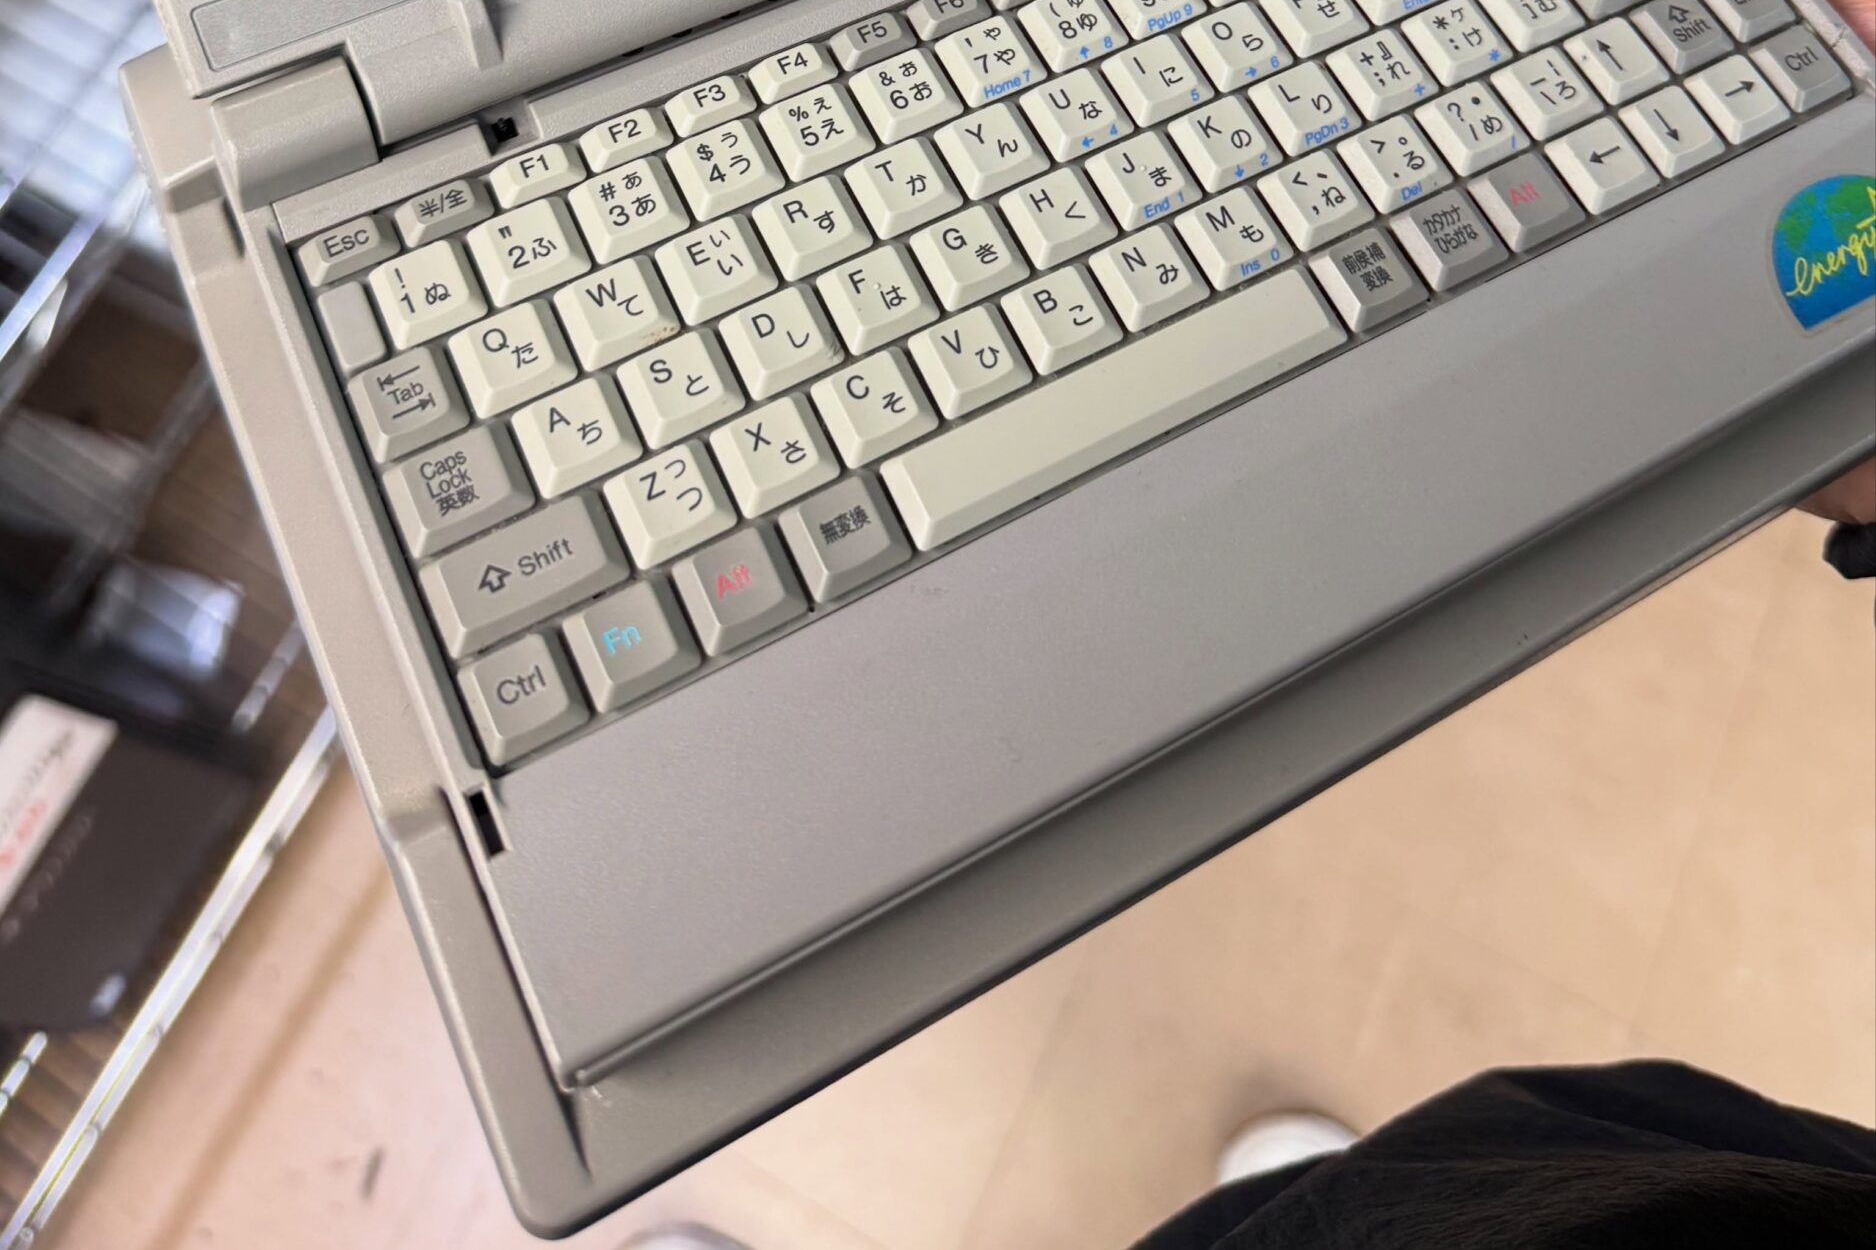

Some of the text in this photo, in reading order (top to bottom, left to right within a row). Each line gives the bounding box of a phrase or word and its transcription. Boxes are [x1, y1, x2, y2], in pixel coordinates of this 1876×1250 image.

[1147, 4, 1193, 31] PgUp 9
[1317, 0, 1340, 18] せ
[857, 22, 887, 43] F5
[1058, 13, 1097, 38] 8 ゆ
[1462, 28, 1483, 47] け
[1673, 18, 1710, 42] Shift
[1104, 37, 1112, 49] 8
[1242, 34, 1263, 51] ら
[777, 53, 808, 75] F4
[974, 48, 1015, 74] 7 や
[1270, 57, 1279, 68] 6
[1387, 61, 1410, 79] れ
[1784, 47, 1820, 72] Ctrl
[983, 70, 1032, 99] Home 7
[1159, 67, 1183, 87] に
[1556, 81, 1576, 99] ろ
[693, 85, 726, 108] F3
[890, 82, 932, 109] 6 お
[1049, 89, 1102, 119] U な
[1191, 89, 1199, 101] 5
[1278, 84, 1333, 114] L り
[611, 117, 642, 143] F2
[802, 119, 844, 145] 5 え
[1109, 124, 1118, 137] 4
[1198, 117, 1251, 149] K の
[1304, 118, 1350, 146] PgDn 3
[1481, 116, 1503, 134] め
[965, 124, 1018, 157] Y ん
[520, 155, 550, 177] F1
[709, 156, 751, 183] 4 う
[1122, 153, 1172, 188] J ま
[1260, 154, 1269, 166] 2
[1404, 151, 1425, 170] る
[876, 162, 927, 195] T か
[1401, 182, 1422, 200] Del
[418, 189, 468, 217] 半/全
[1029, 189, 1086, 219] H く
[1143, 198, 1171, 218] End
[1322, 186, 1346, 207] ね
[1509, 182, 1539, 206] Alt
[609, 193, 656, 226] 3 あ
[783, 201, 836, 233] R す
[1422, 204, 1461, 235] カタカナ
[1206, 206, 1264, 243] M も
[323, 228, 370, 257] Esc
[508, 238, 557, 268] 2 ふ
[942, 228, 998, 264] G き
[1435, 224, 1479, 254] ひらがな
[687, 242, 710, 265] E
[717, 254, 743, 276] い
[1122, 248, 1179, 284] N み
[1341, 242, 1386, 275] 前候補
[1240, 259, 1261, 277] Ins
[1360, 267, 1392, 291] 変換
[402, 283, 451, 313] 1 ぬ
[586, 279, 644, 317] W て
[849, 270, 906, 309] F は
[1033, 289, 1093, 326] B こ
[752, 313, 809, 348] D し
[482, 328, 539, 368] Q た
[941, 330, 999, 368] V ひ
[650, 360, 709, 395] S と
[388, 382, 424, 405] Tab
[846, 375, 906, 413] C そ
[549, 407, 602, 444] A ち
[745, 423, 807, 463] X さ
[420, 452, 467, 480] Caps
[427, 469, 473, 499] Lock
[640, 472, 666, 501] Z
[436, 489, 479, 516] 英数
[677, 488, 702, 511] つ
[819, 506, 871, 544] 無変換
[518, 538, 574, 575] Shift
[716, 564, 751, 597] Alt
[603, 625, 641, 654] Fn
[497, 666, 546, 705] Ctrl
